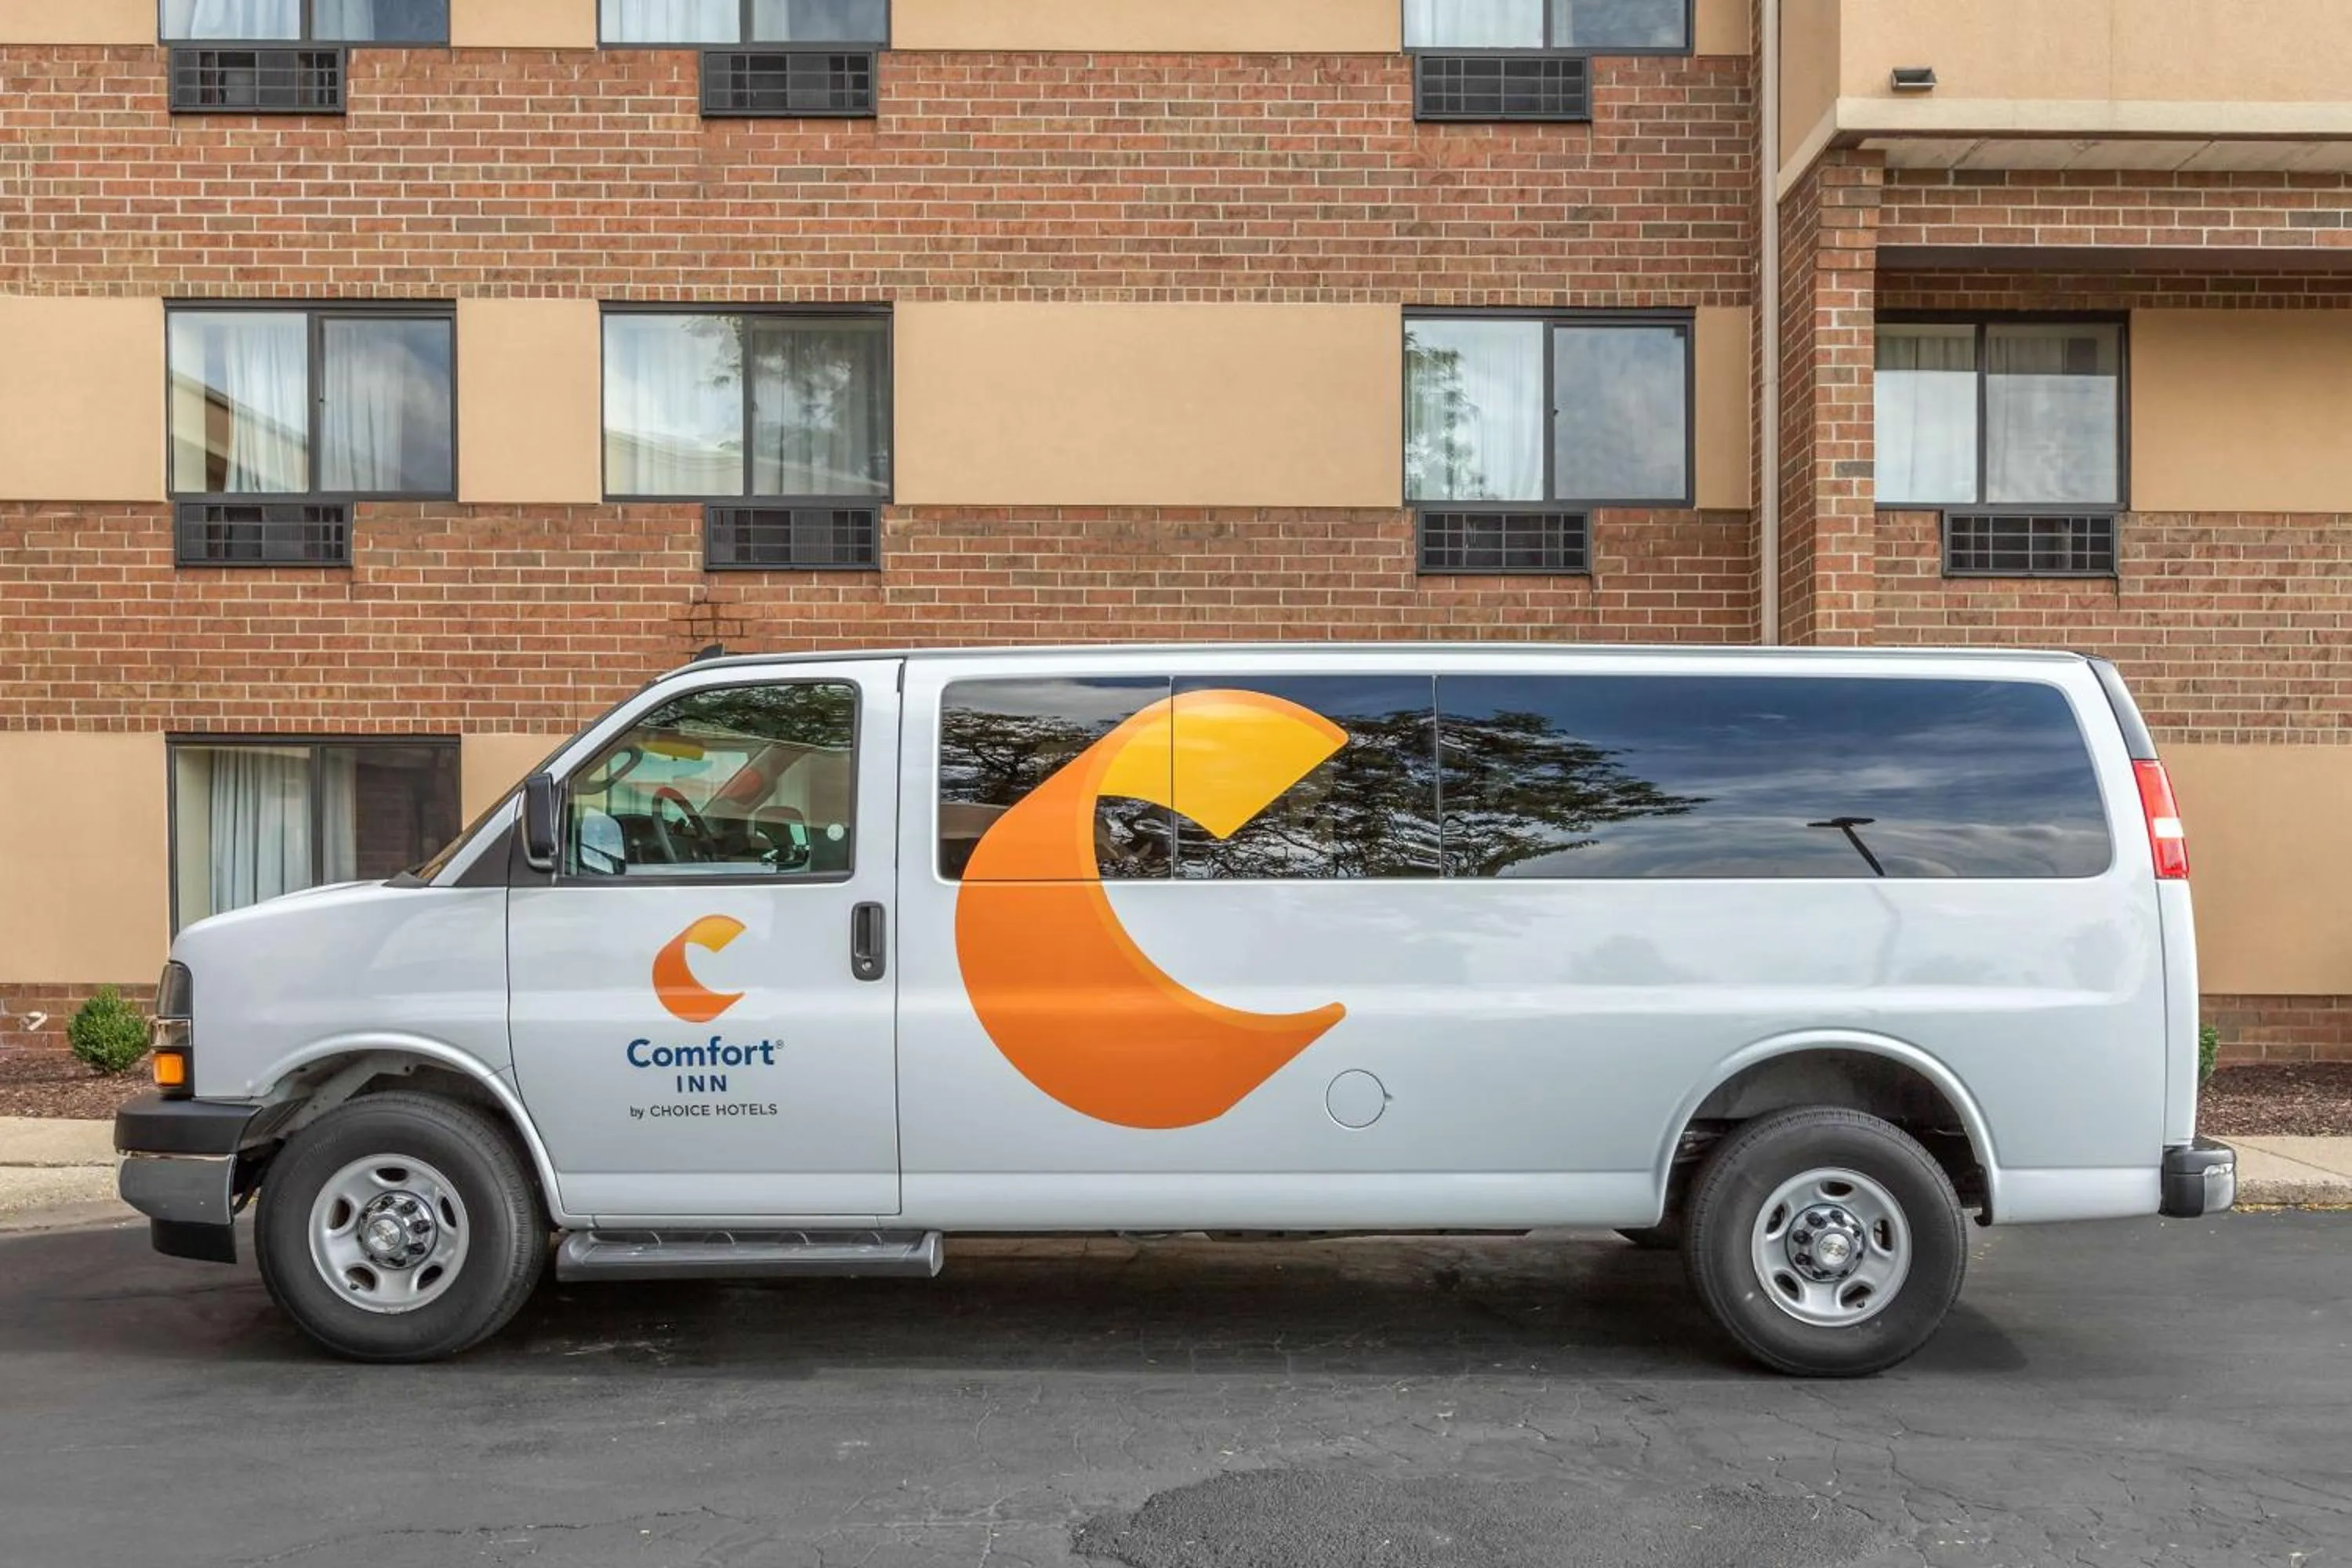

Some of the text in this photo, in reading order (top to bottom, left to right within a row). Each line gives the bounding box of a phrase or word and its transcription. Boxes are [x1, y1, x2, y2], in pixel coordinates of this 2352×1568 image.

[677, 1075, 728, 1093] INN
[630, 1104, 778, 1120] by CHOICE HOTELS
